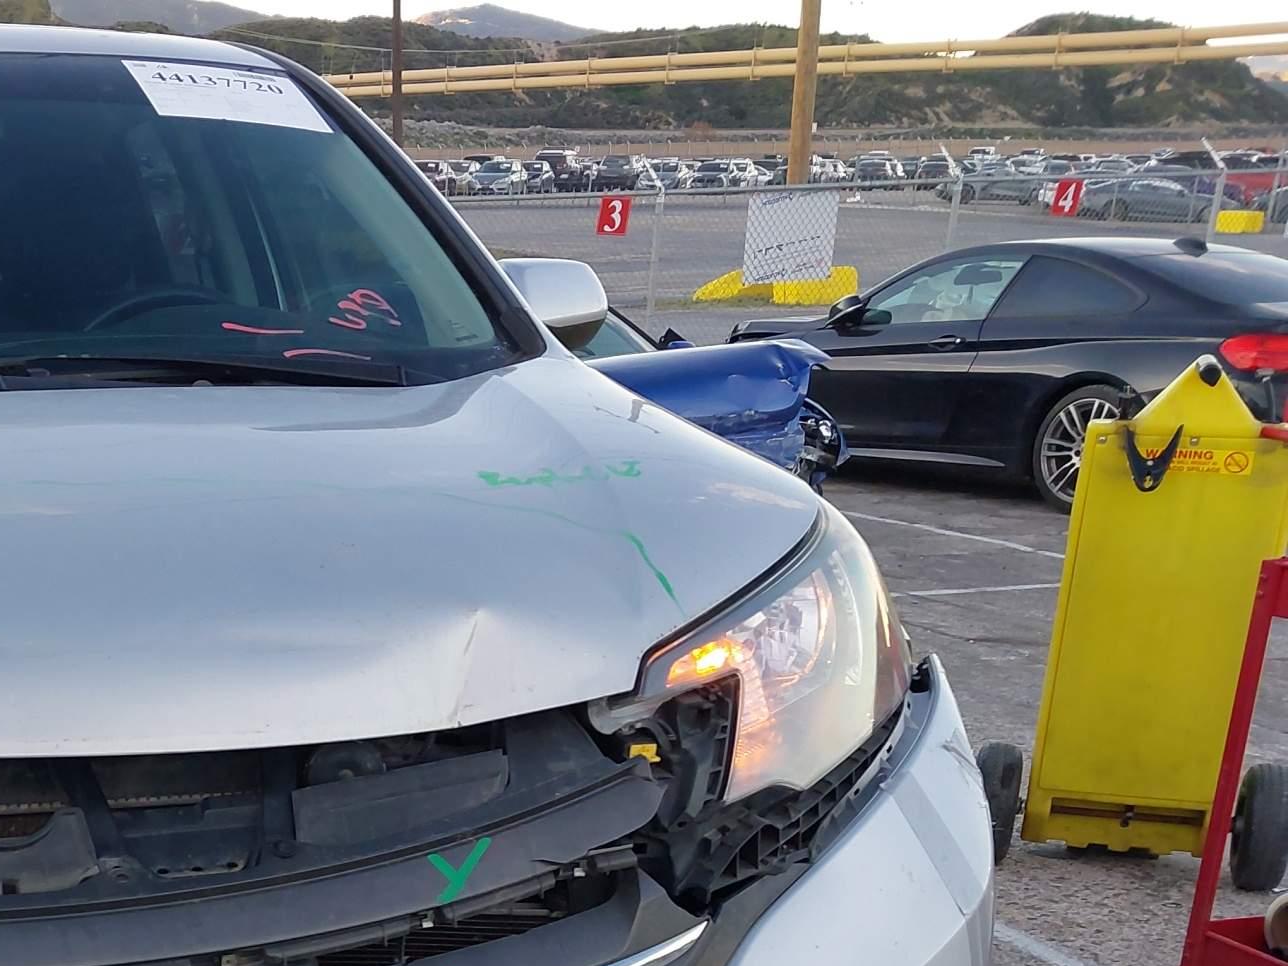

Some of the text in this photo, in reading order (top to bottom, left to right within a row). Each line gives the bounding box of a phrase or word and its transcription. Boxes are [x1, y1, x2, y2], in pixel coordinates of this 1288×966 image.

[151, 70, 284, 95] 44137720
[1058, 182, 1077, 213] 4
[603, 199, 623, 232] 3
